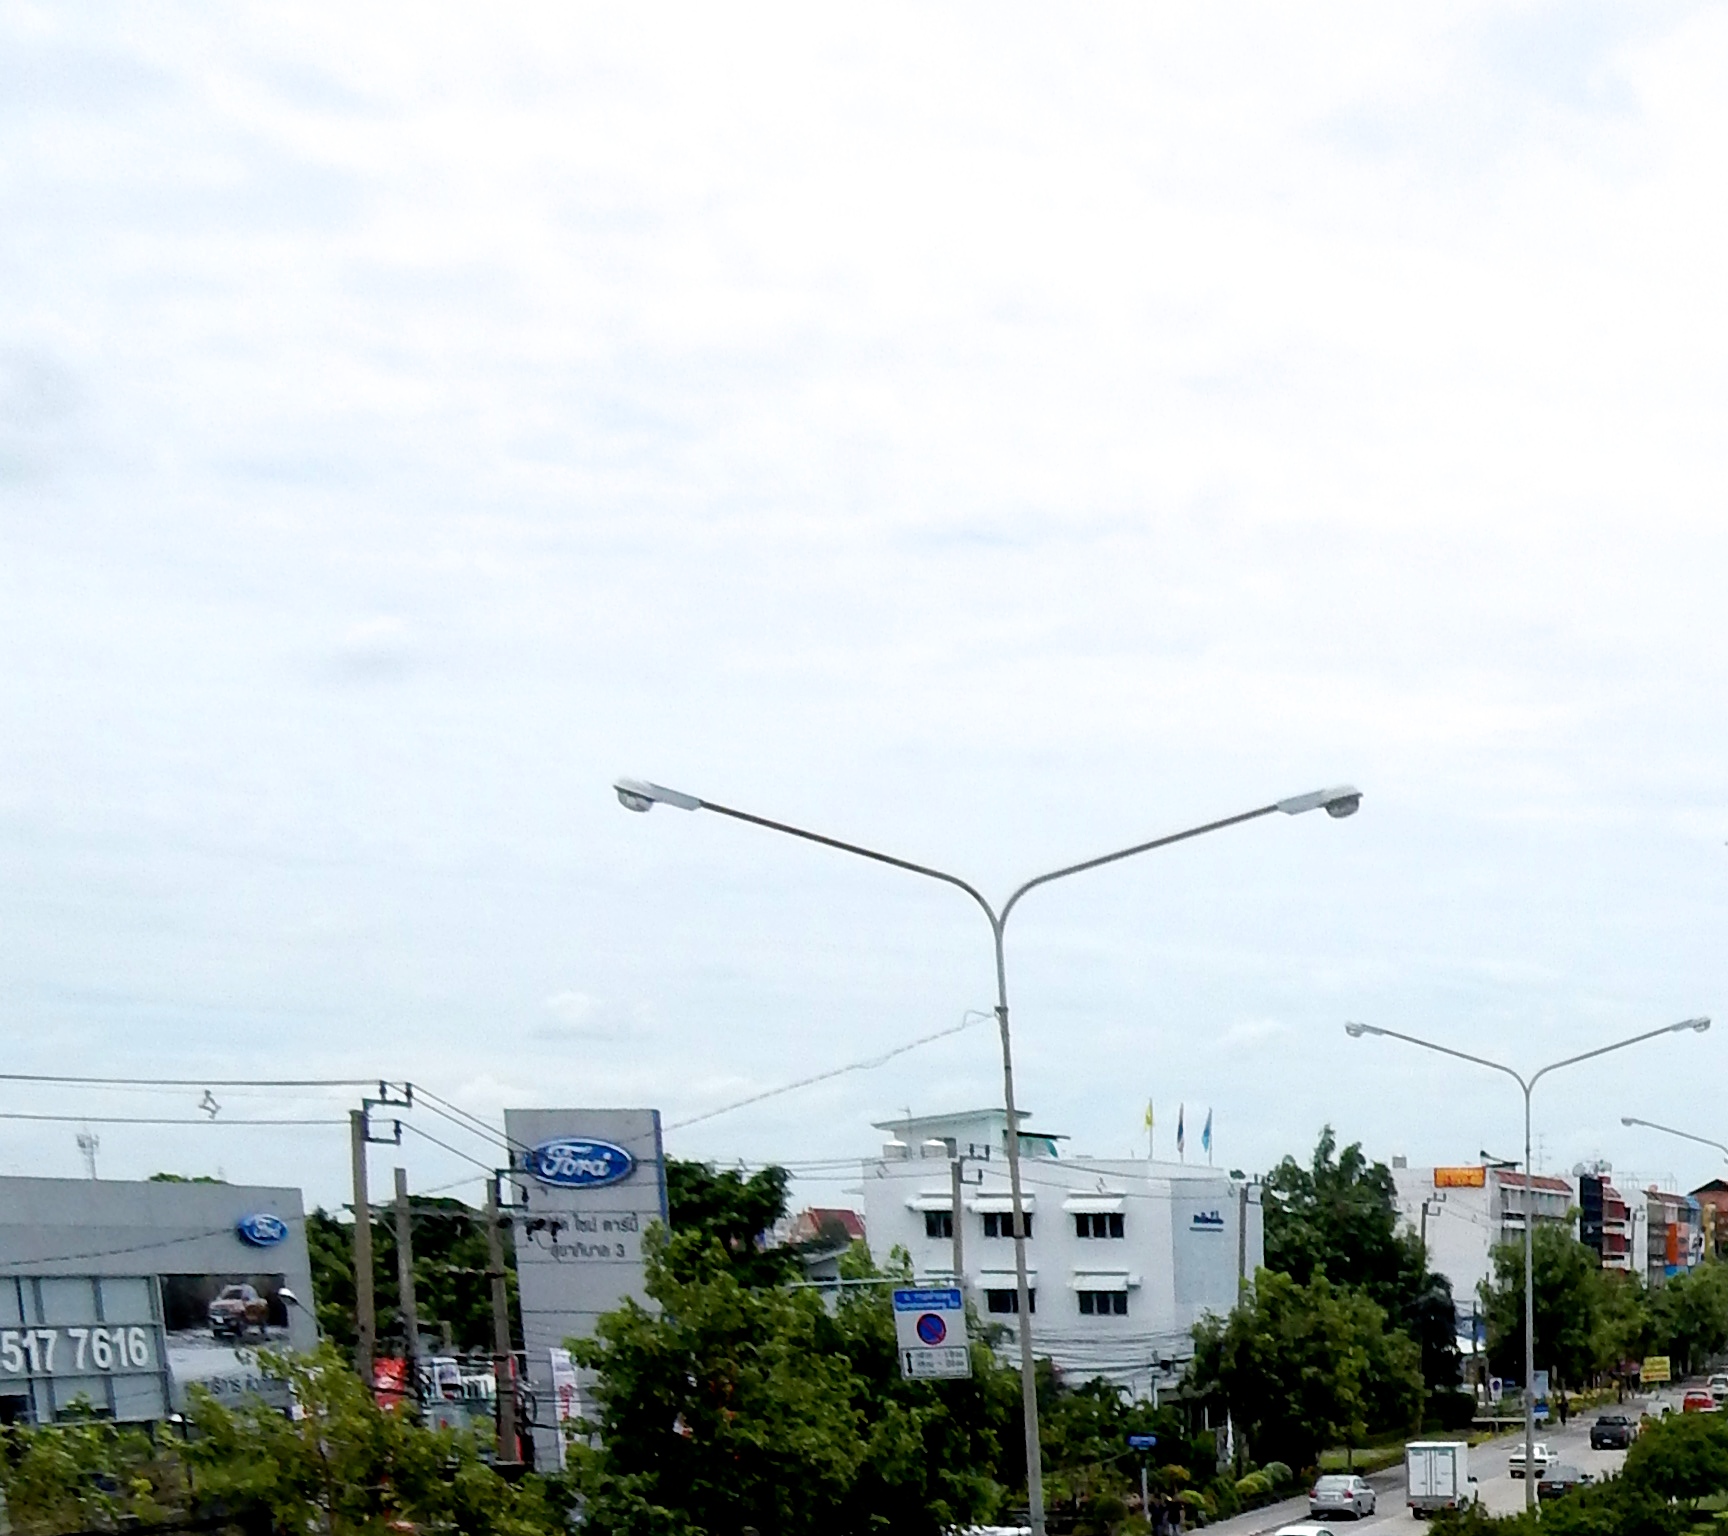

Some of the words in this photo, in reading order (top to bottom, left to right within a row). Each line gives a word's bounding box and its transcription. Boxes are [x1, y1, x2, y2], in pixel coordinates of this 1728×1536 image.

[539, 1144, 611, 1177] Ford
[616, 1243, 625, 1258] 3
[1, 1329, 57, 1374] 517
[69, 1326, 149, 1370] 7616
